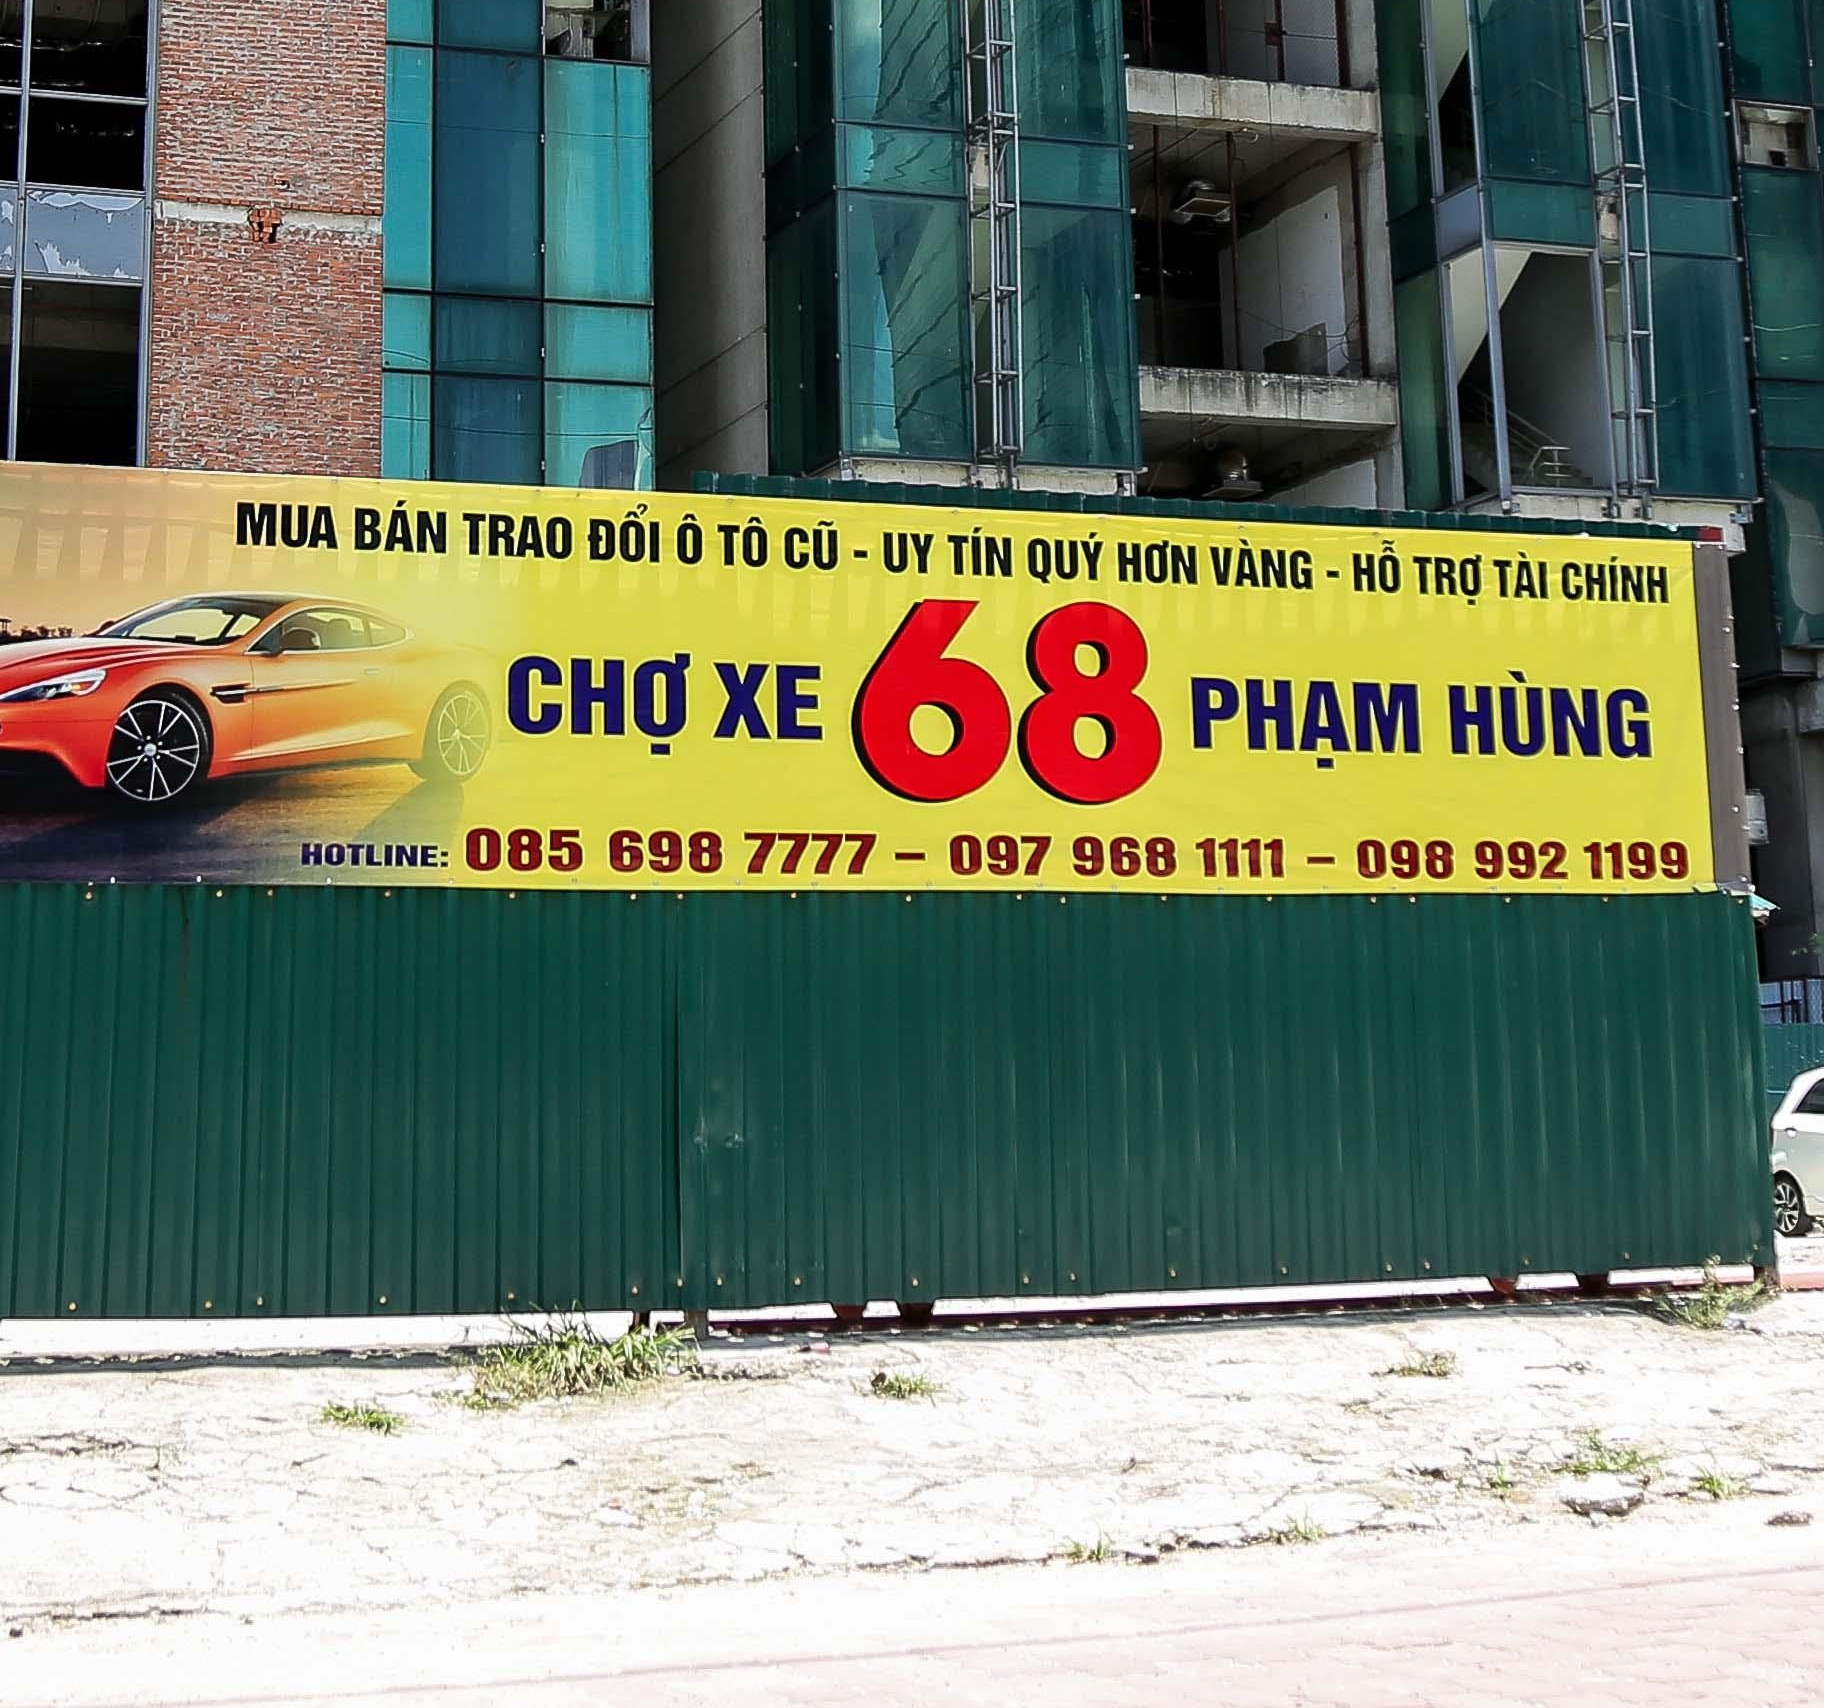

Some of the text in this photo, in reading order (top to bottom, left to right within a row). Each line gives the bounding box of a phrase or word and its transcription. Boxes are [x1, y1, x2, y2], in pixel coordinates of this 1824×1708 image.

[237, 502, 337, 549] MUA
[355, 500, 446, 553] BÁN
[463, 513, 571, 559] TRAO
[588, 504, 659, 562] ĐỔI
[677, 514, 702, 564] Ô
[718, 517, 767, 567] TÔ
[785, 521, 837, 570] CŨ
[884, 532, 933, 573] UY
[948, 527, 1011, 577] TÍN
[1028, 532, 1102, 583] QUÝ
[1118, 540, 1197, 584] HƠN
[1210, 539, 1312, 589] VÀNG
[1353, 540, 1400, 593] HỖ
[1413, 555, 1481, 605] TRỢ
[1493, 552, 1547, 598] TÀI
[1562, 557, 1668, 603] CHÍNH
[508, 599, 1651, 805] CHỢ XE 68 PHẠM HÙNG
[301, 843, 448, 867] HOTLINE:
[466, 828, 582, 871] 085
[609, 830, 722, 873] 698
[745, 833, 876, 874] 7777
[950, 835, 1051, 875] 097
[1073, 836, 1176, 877] 968
[1196, 838, 1283, 877] 1111
[1357, 840, 1453, 879] 098
[1475, 841, 1567, 879] 992
[1584, 842, 1688, 879] 1199
